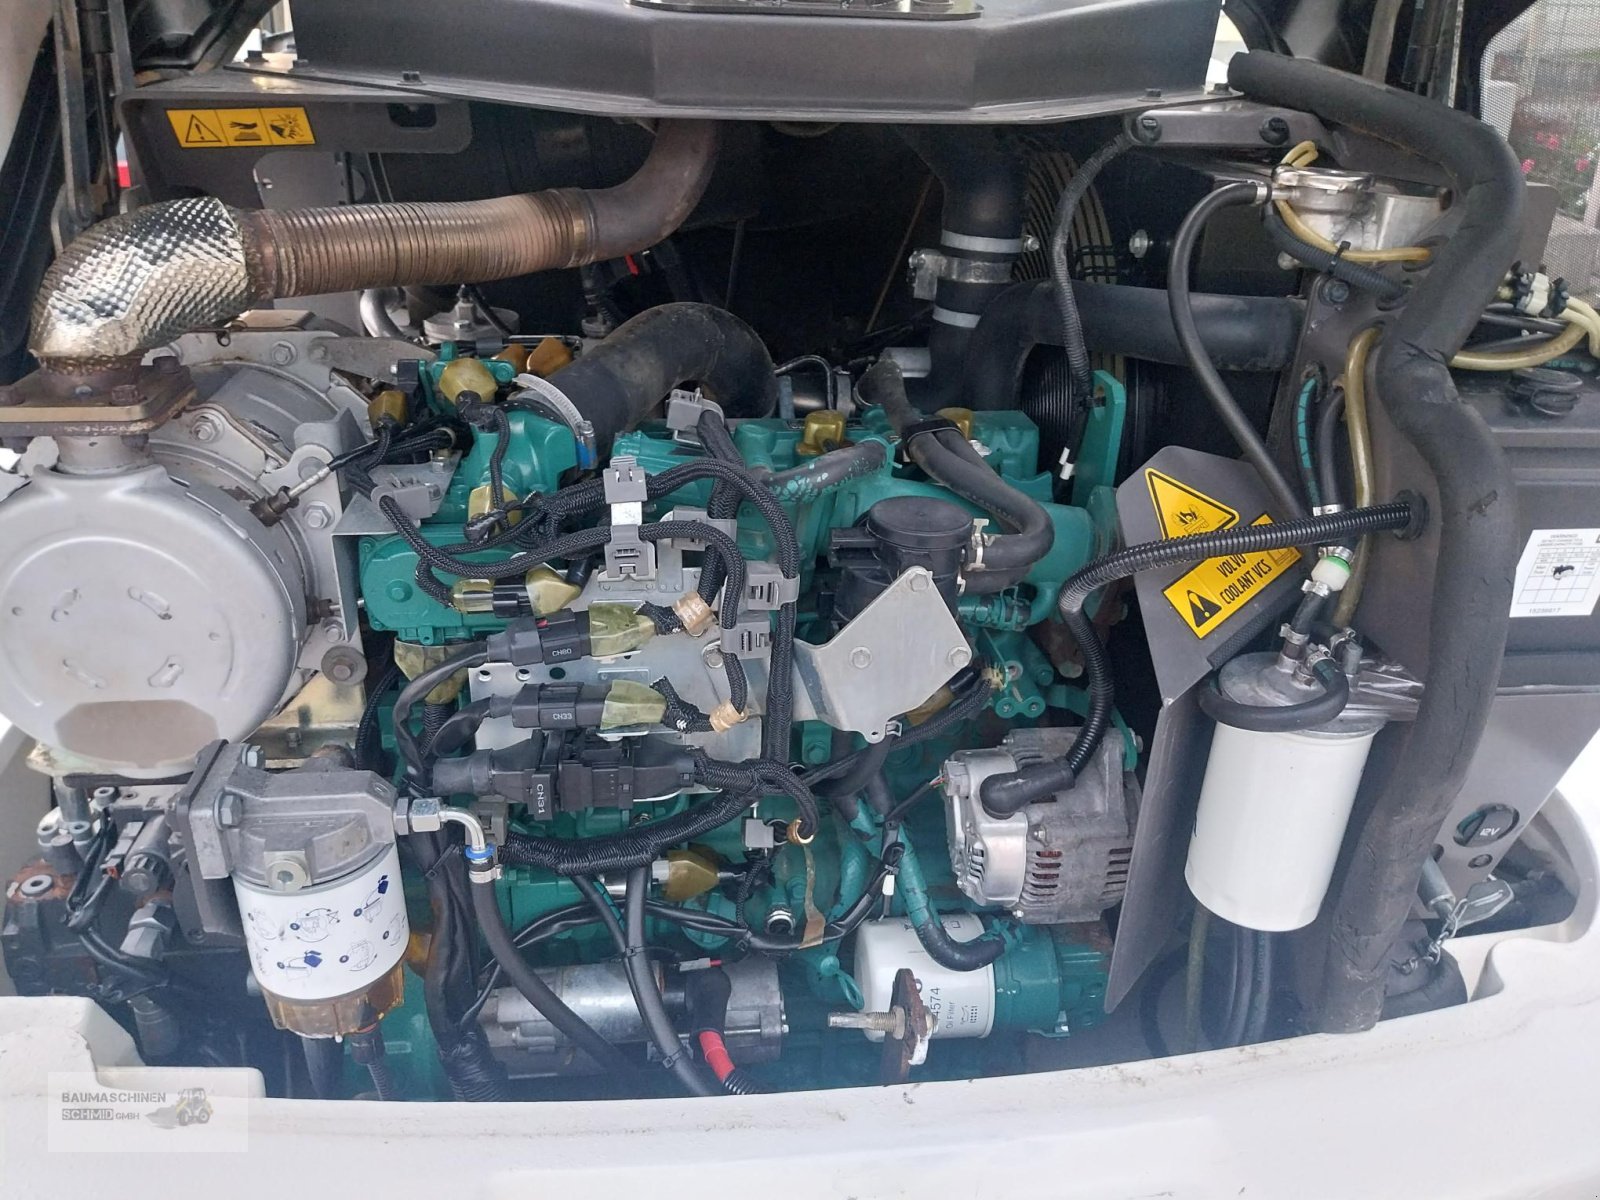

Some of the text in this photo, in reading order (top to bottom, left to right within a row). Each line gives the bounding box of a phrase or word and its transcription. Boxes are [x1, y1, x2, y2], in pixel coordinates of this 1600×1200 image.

[1216, 553, 1247, 578] VOLVO
[1219, 558, 1272, 604] COOLANT VCS
[536, 783, 546, 814] CN31
